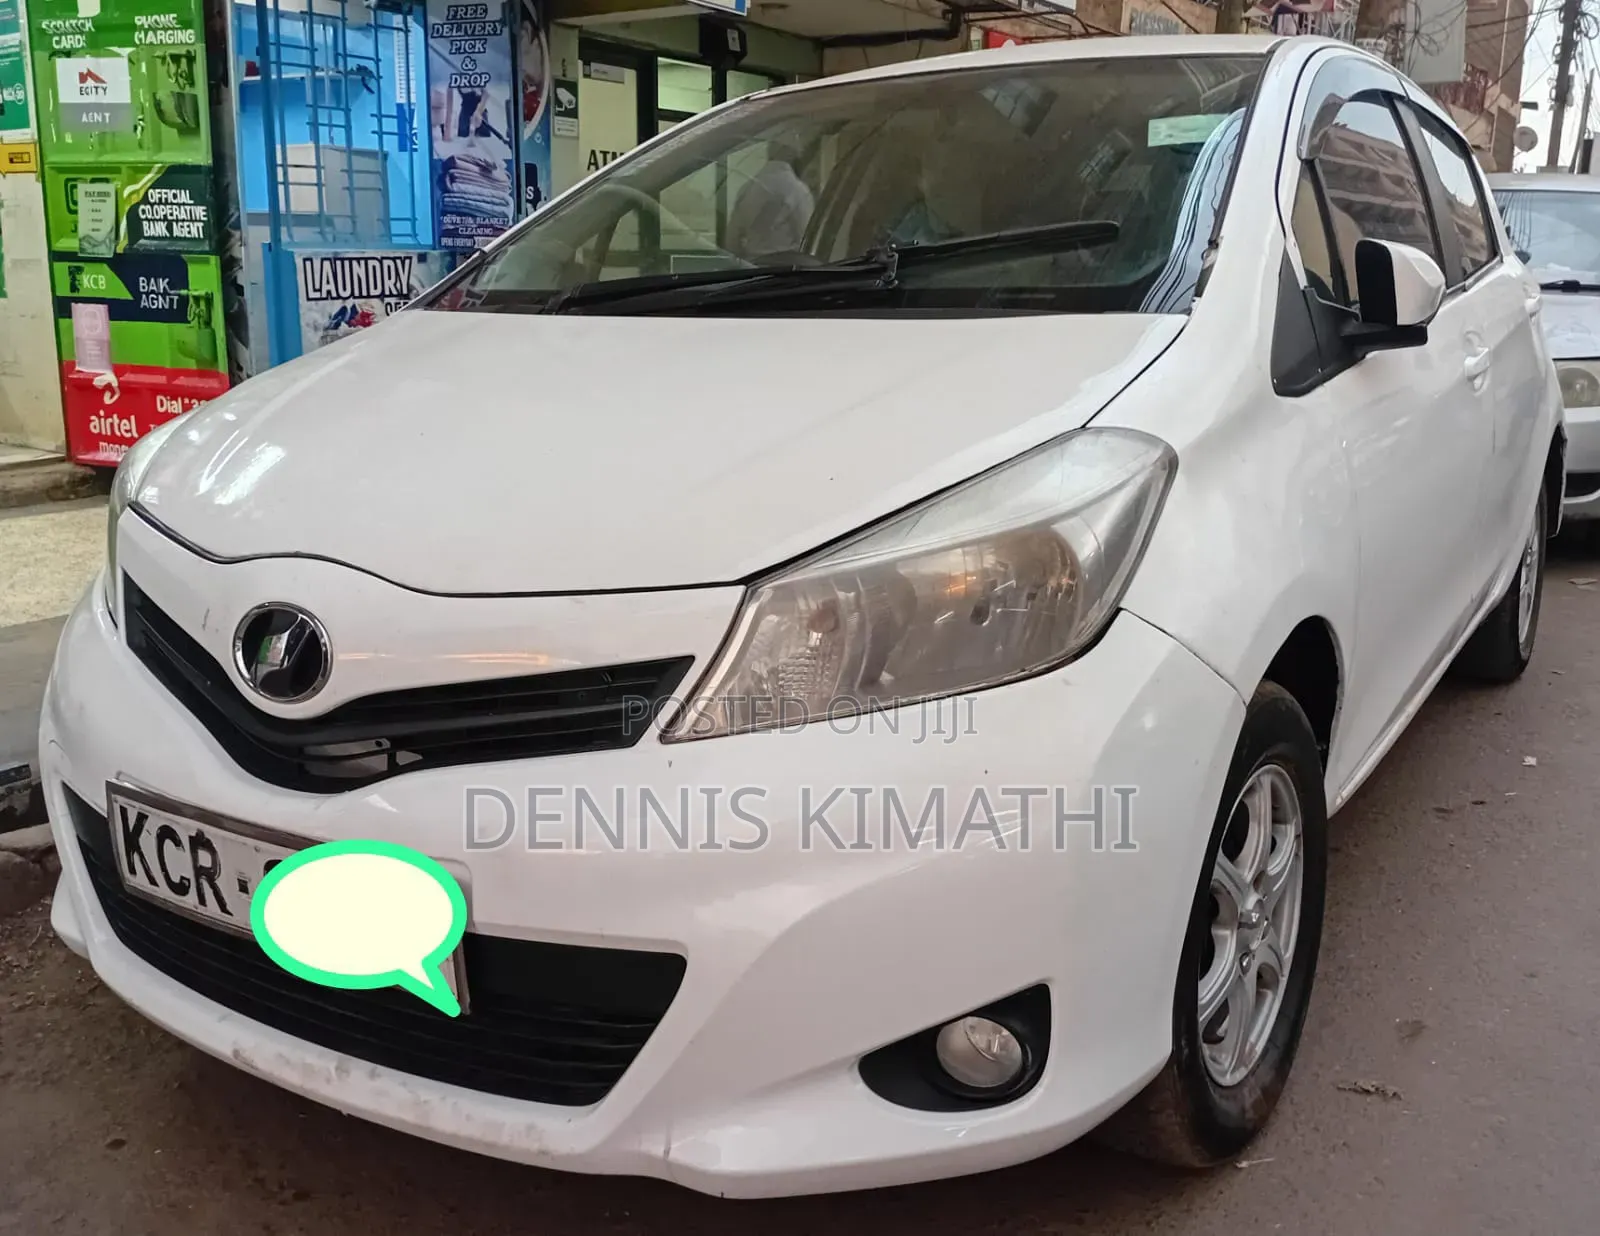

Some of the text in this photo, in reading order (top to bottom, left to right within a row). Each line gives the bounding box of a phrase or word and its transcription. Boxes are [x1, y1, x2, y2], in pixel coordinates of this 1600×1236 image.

[447, 4, 487, 20] FREE
[41, 18, 95, 34] SCRATCH
[134, 14, 182, 29] PHONE
[431, 21, 503, 38] DELIVERY
[450, 39, 487, 54] PICK
[461, 56, 477, 71] &
[449, 73, 491, 88] DROP
[148, 188, 195, 204] OFFICIAL
[476, 216, 508, 225] BLANKET
[142, 220, 204, 239] BANK AGENT
[458, 227, 493, 236] CLEANING
[82, 274, 107, 290] KCB
[303, 256, 413, 301] LAUNDRY
[156, 395, 183, 414] Dial
[89, 409, 139, 438] airtel
[119, 804, 234, 917] KCR
